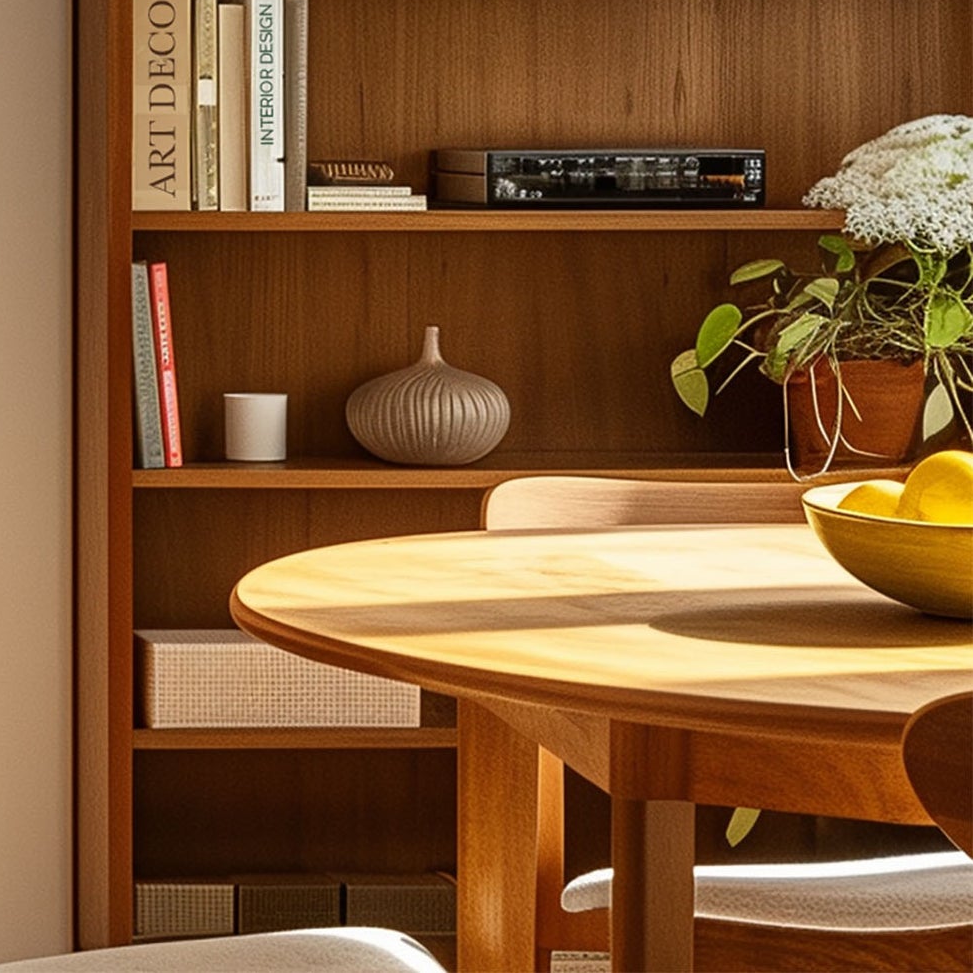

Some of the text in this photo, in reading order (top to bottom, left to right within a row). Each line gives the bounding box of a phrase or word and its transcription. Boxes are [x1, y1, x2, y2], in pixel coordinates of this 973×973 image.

[147, 0, 177, 198] ART DECO
[258, 3, 275, 146] INTERIOR DESIGN
